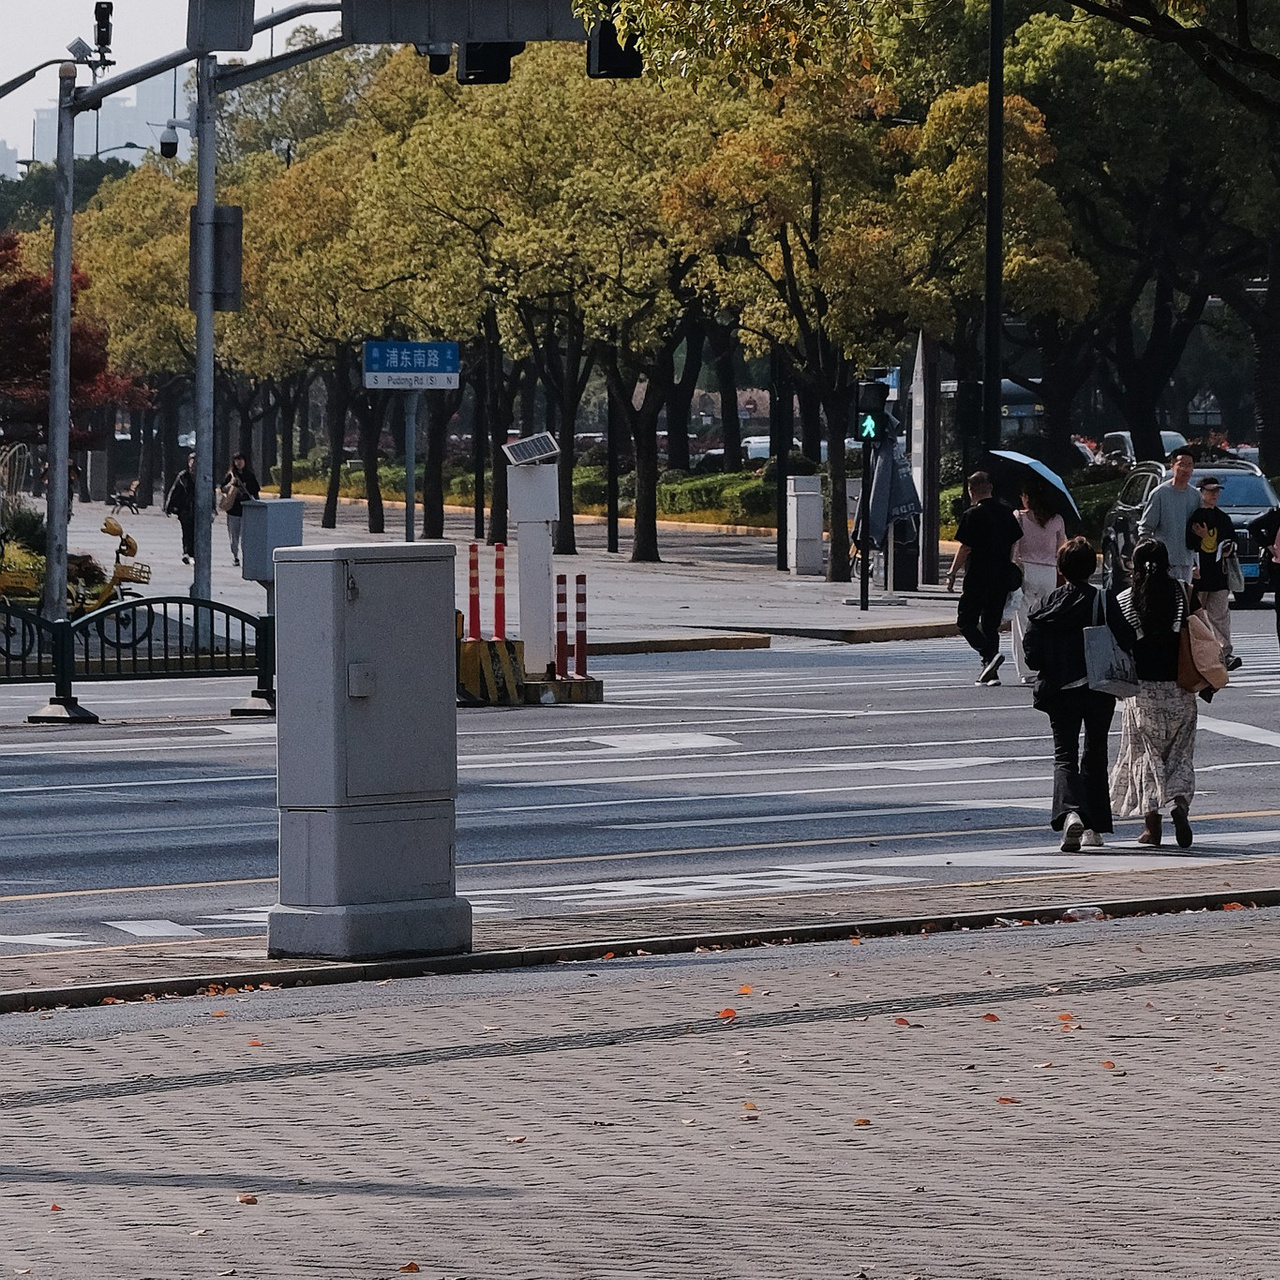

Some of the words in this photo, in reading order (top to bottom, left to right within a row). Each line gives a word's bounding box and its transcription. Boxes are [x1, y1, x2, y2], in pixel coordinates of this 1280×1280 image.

[386, 348, 440, 368] 浦东南路
[387, 375, 413, 388] Pudong
